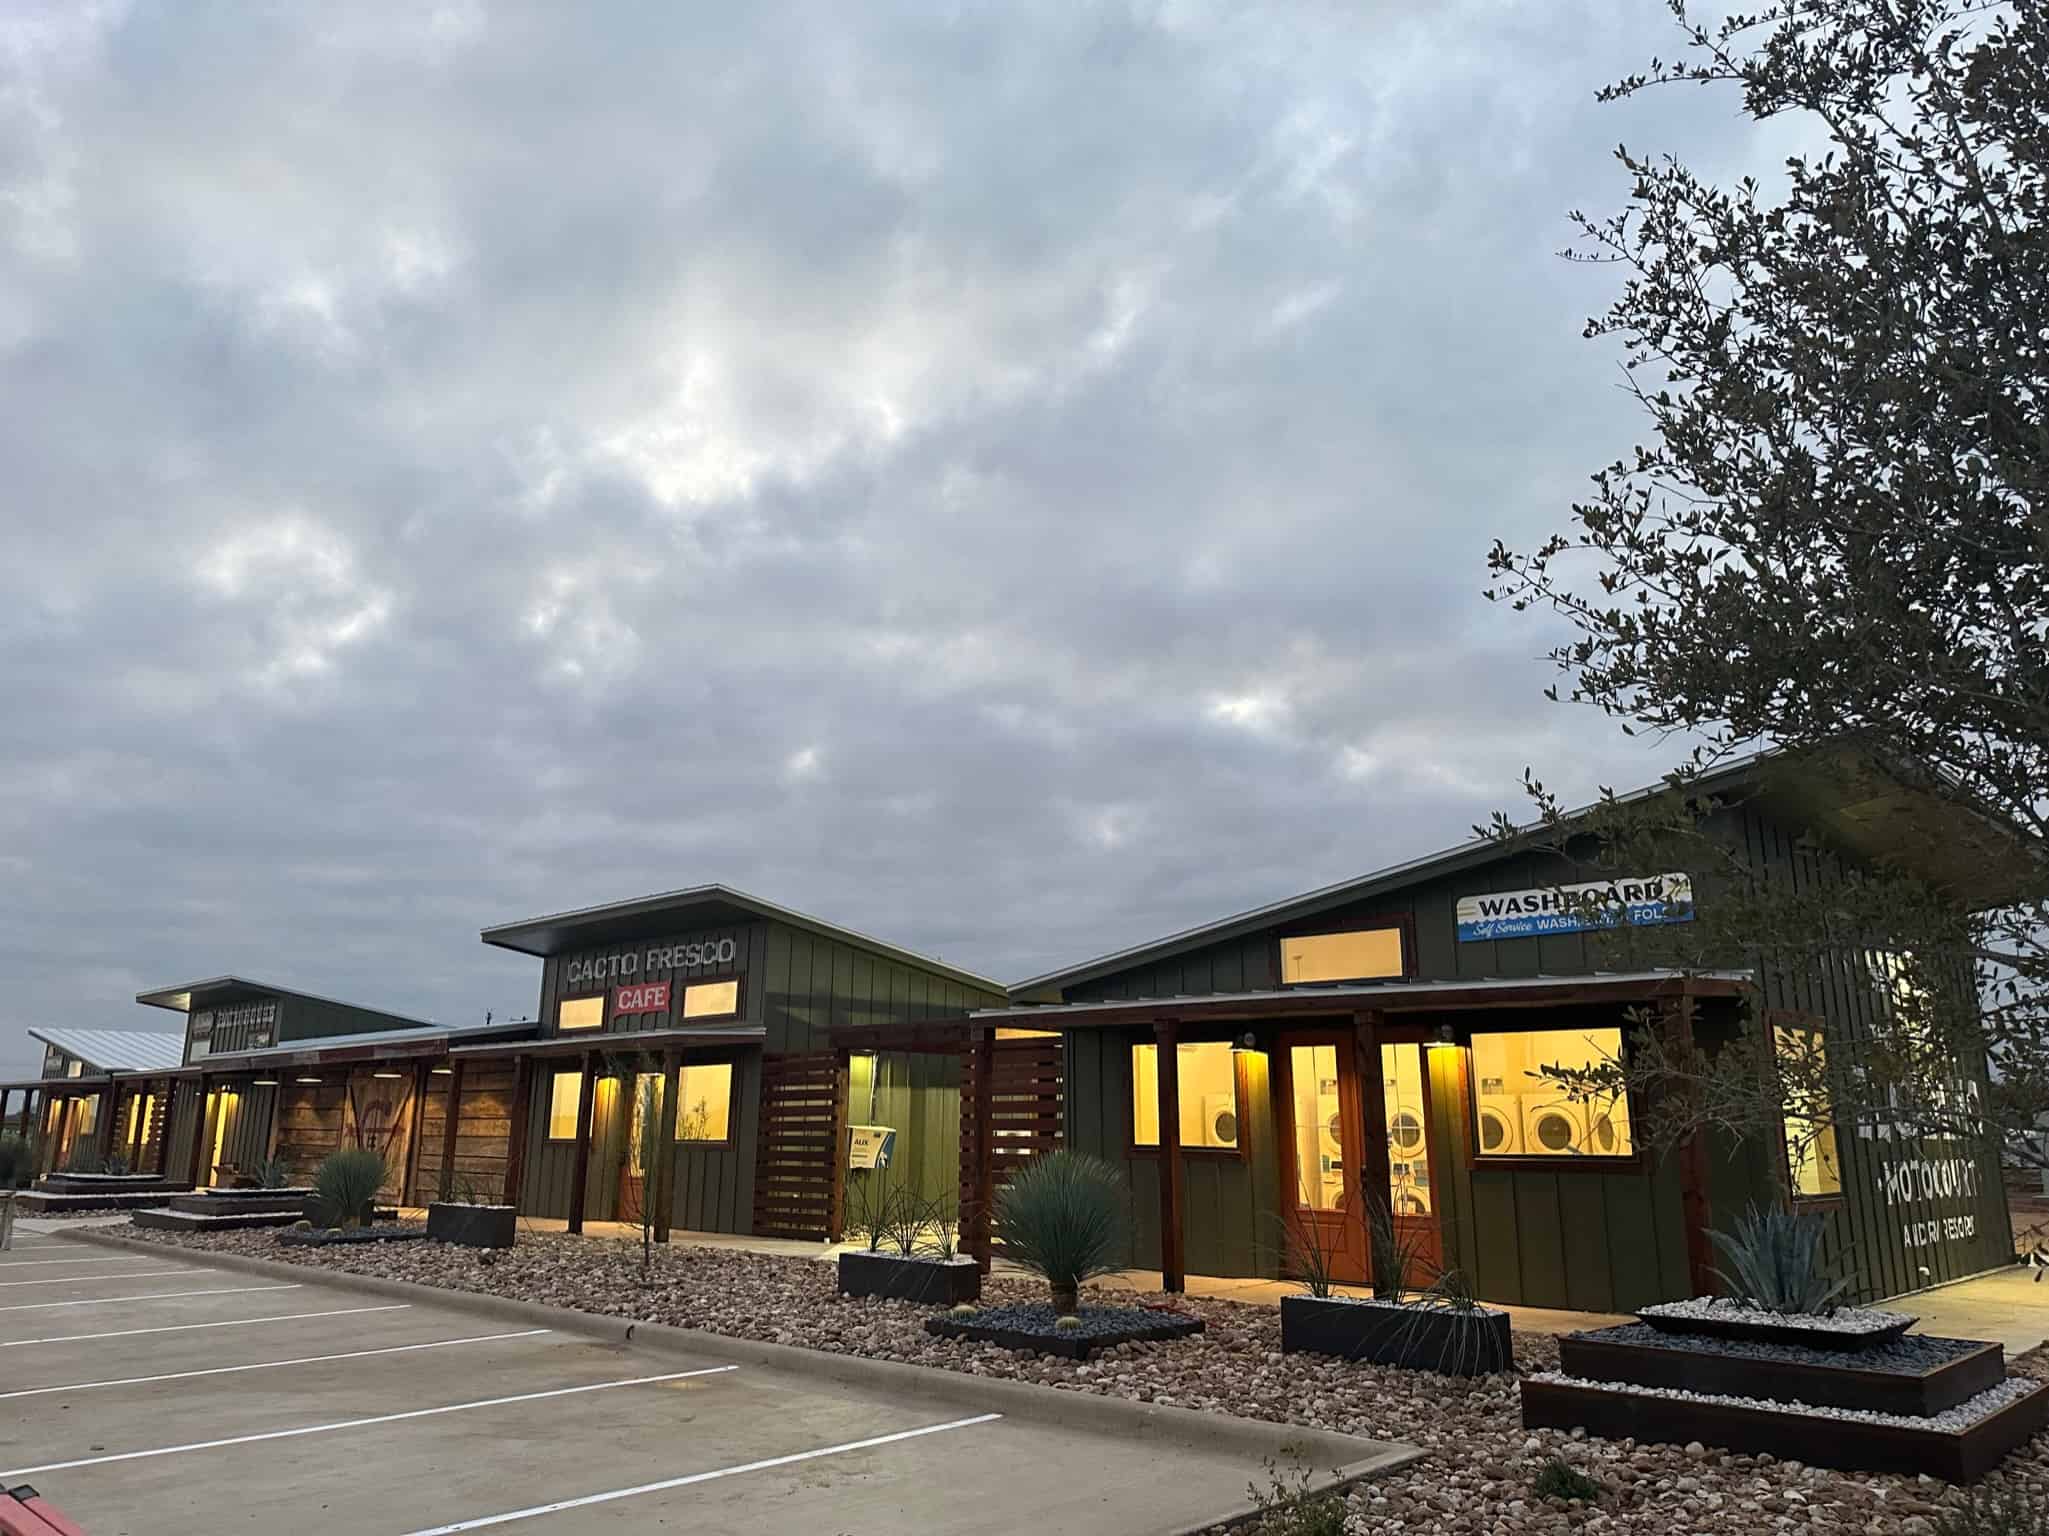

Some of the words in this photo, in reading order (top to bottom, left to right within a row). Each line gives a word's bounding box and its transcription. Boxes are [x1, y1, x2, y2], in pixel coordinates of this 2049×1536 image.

[1472, 922, 1495, 937] Self
[1495, 920, 1533, 934] Service
[1634, 907, 1667, 921] FOL
[567, 953, 638, 983] CACTO
[646, 938, 736, 971] FRESCO
[617, 986, 665, 1009] CAFE
[1882, 1159, 1977, 1206] MOTOCOURT
[1904, 1222, 1928, 1248] AND
[1943, 1215, 1976, 1241] RESORT
